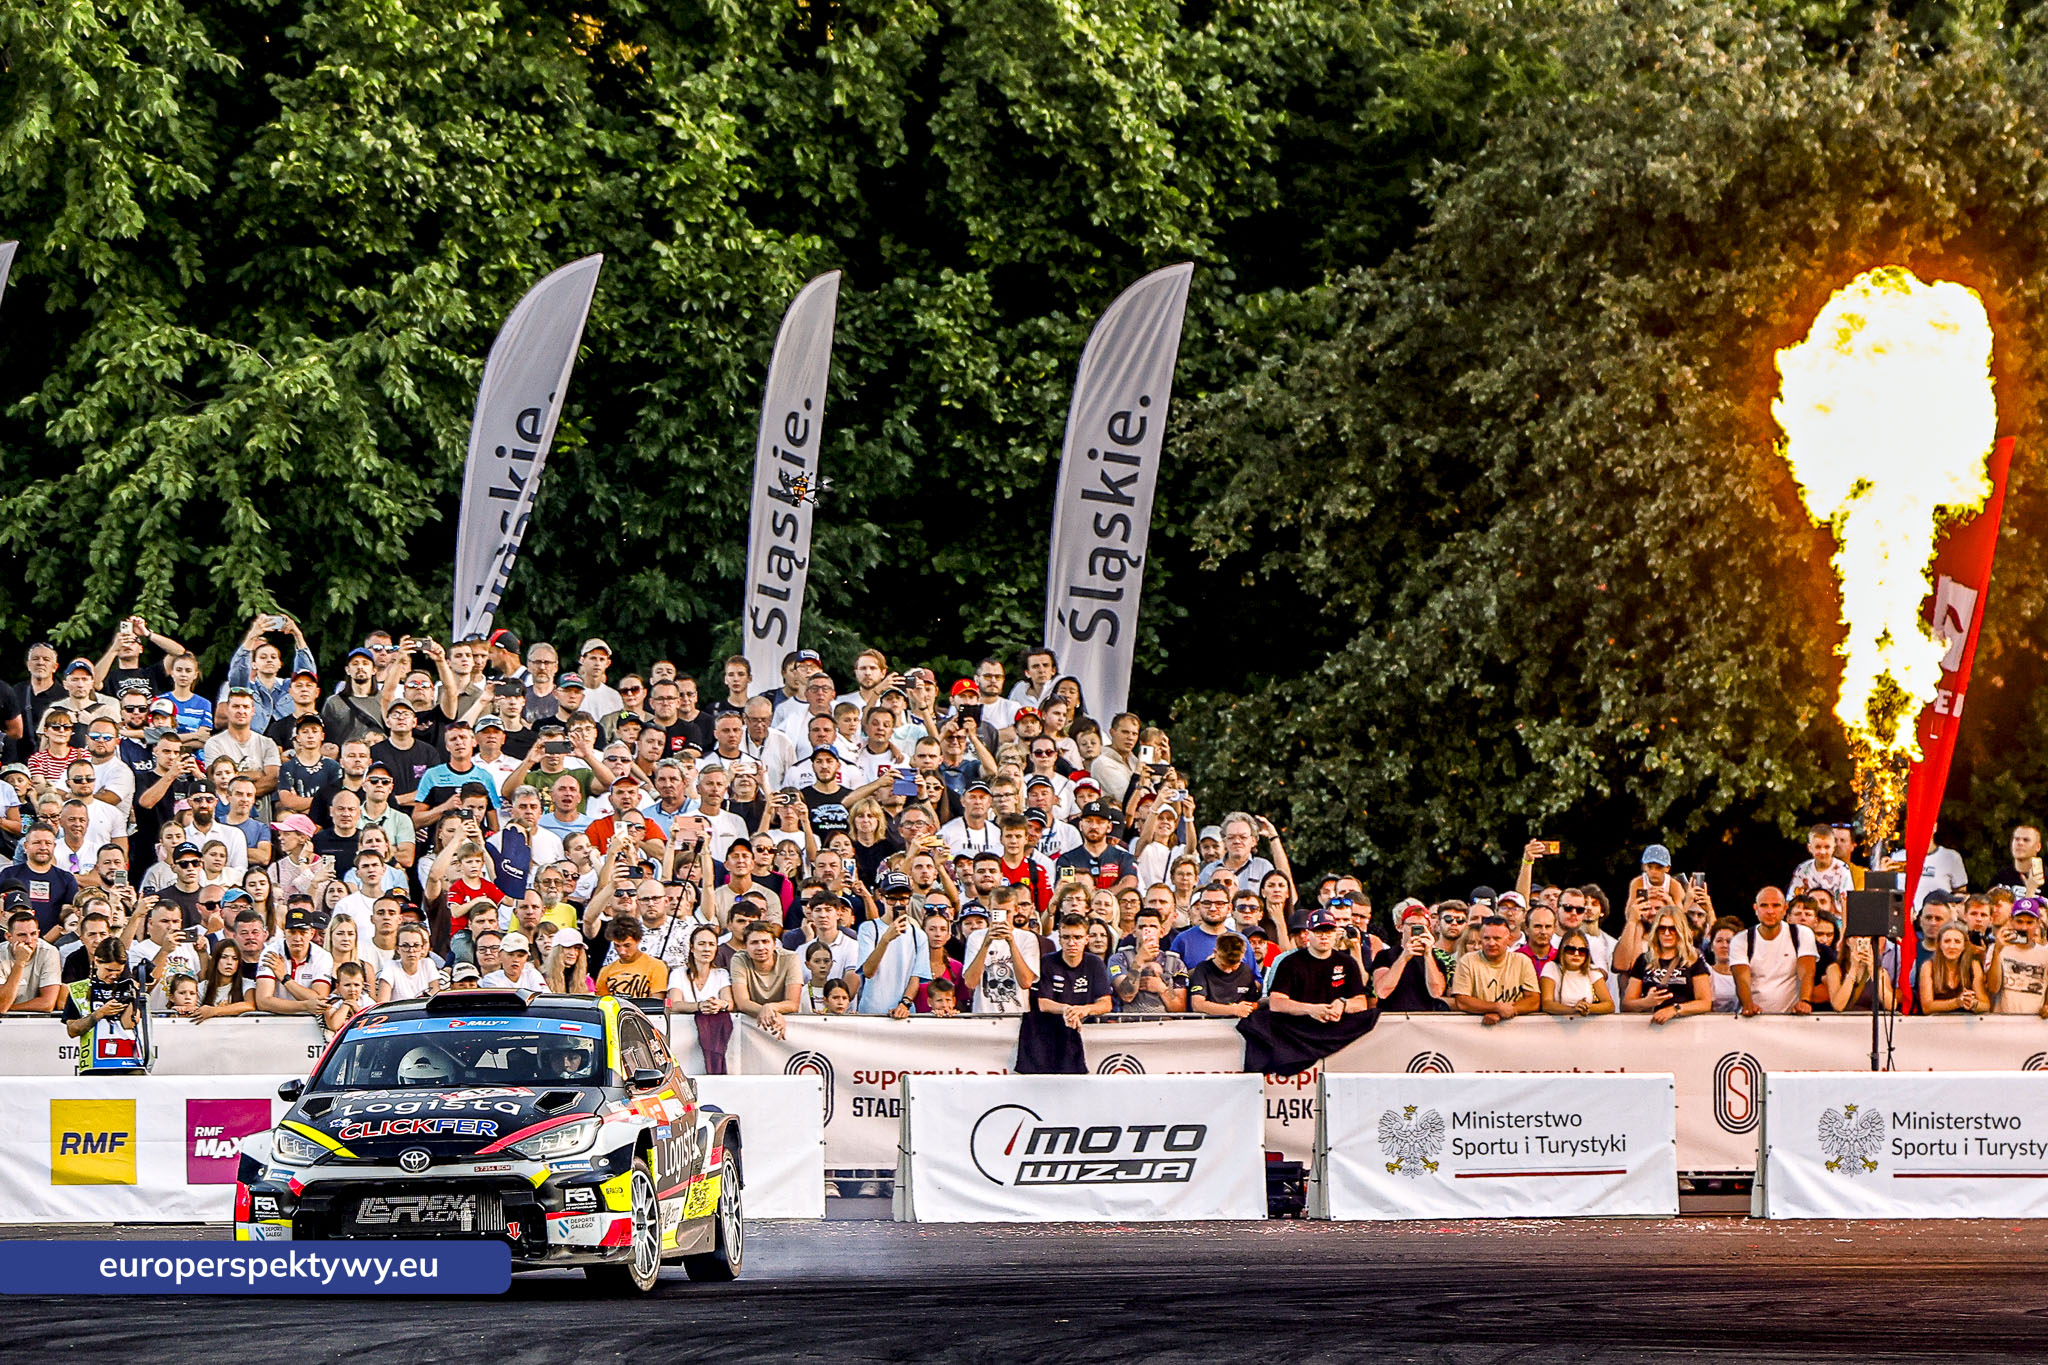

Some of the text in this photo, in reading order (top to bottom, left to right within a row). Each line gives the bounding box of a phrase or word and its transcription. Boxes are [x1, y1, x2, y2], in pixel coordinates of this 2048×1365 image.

[750, 397, 813, 647] Śląskie.
[1057, 394, 1152, 648] Śląskie.
[356, 1015, 390, 1031] 12
[340, 1098, 523, 1117] Logista
[338, 1118, 499, 1140] CLICKFER
[1452, 1110, 1582, 1130] Ministerstwo
[1892, 1111, 2022, 1130] Ministerstwo
[194, 1126, 224, 1137] RMF
[1024, 1124, 1207, 1155] MOTO
[60, 1132, 128, 1155] RMF
[1452, 1134, 1627, 1160] Sportu i Turystyki
[1891, 1137, 1957, 1159] Sportu
[1964, 1138, 1969, 1156] i
[1019, 1161, 1191, 1182] WIZJA
